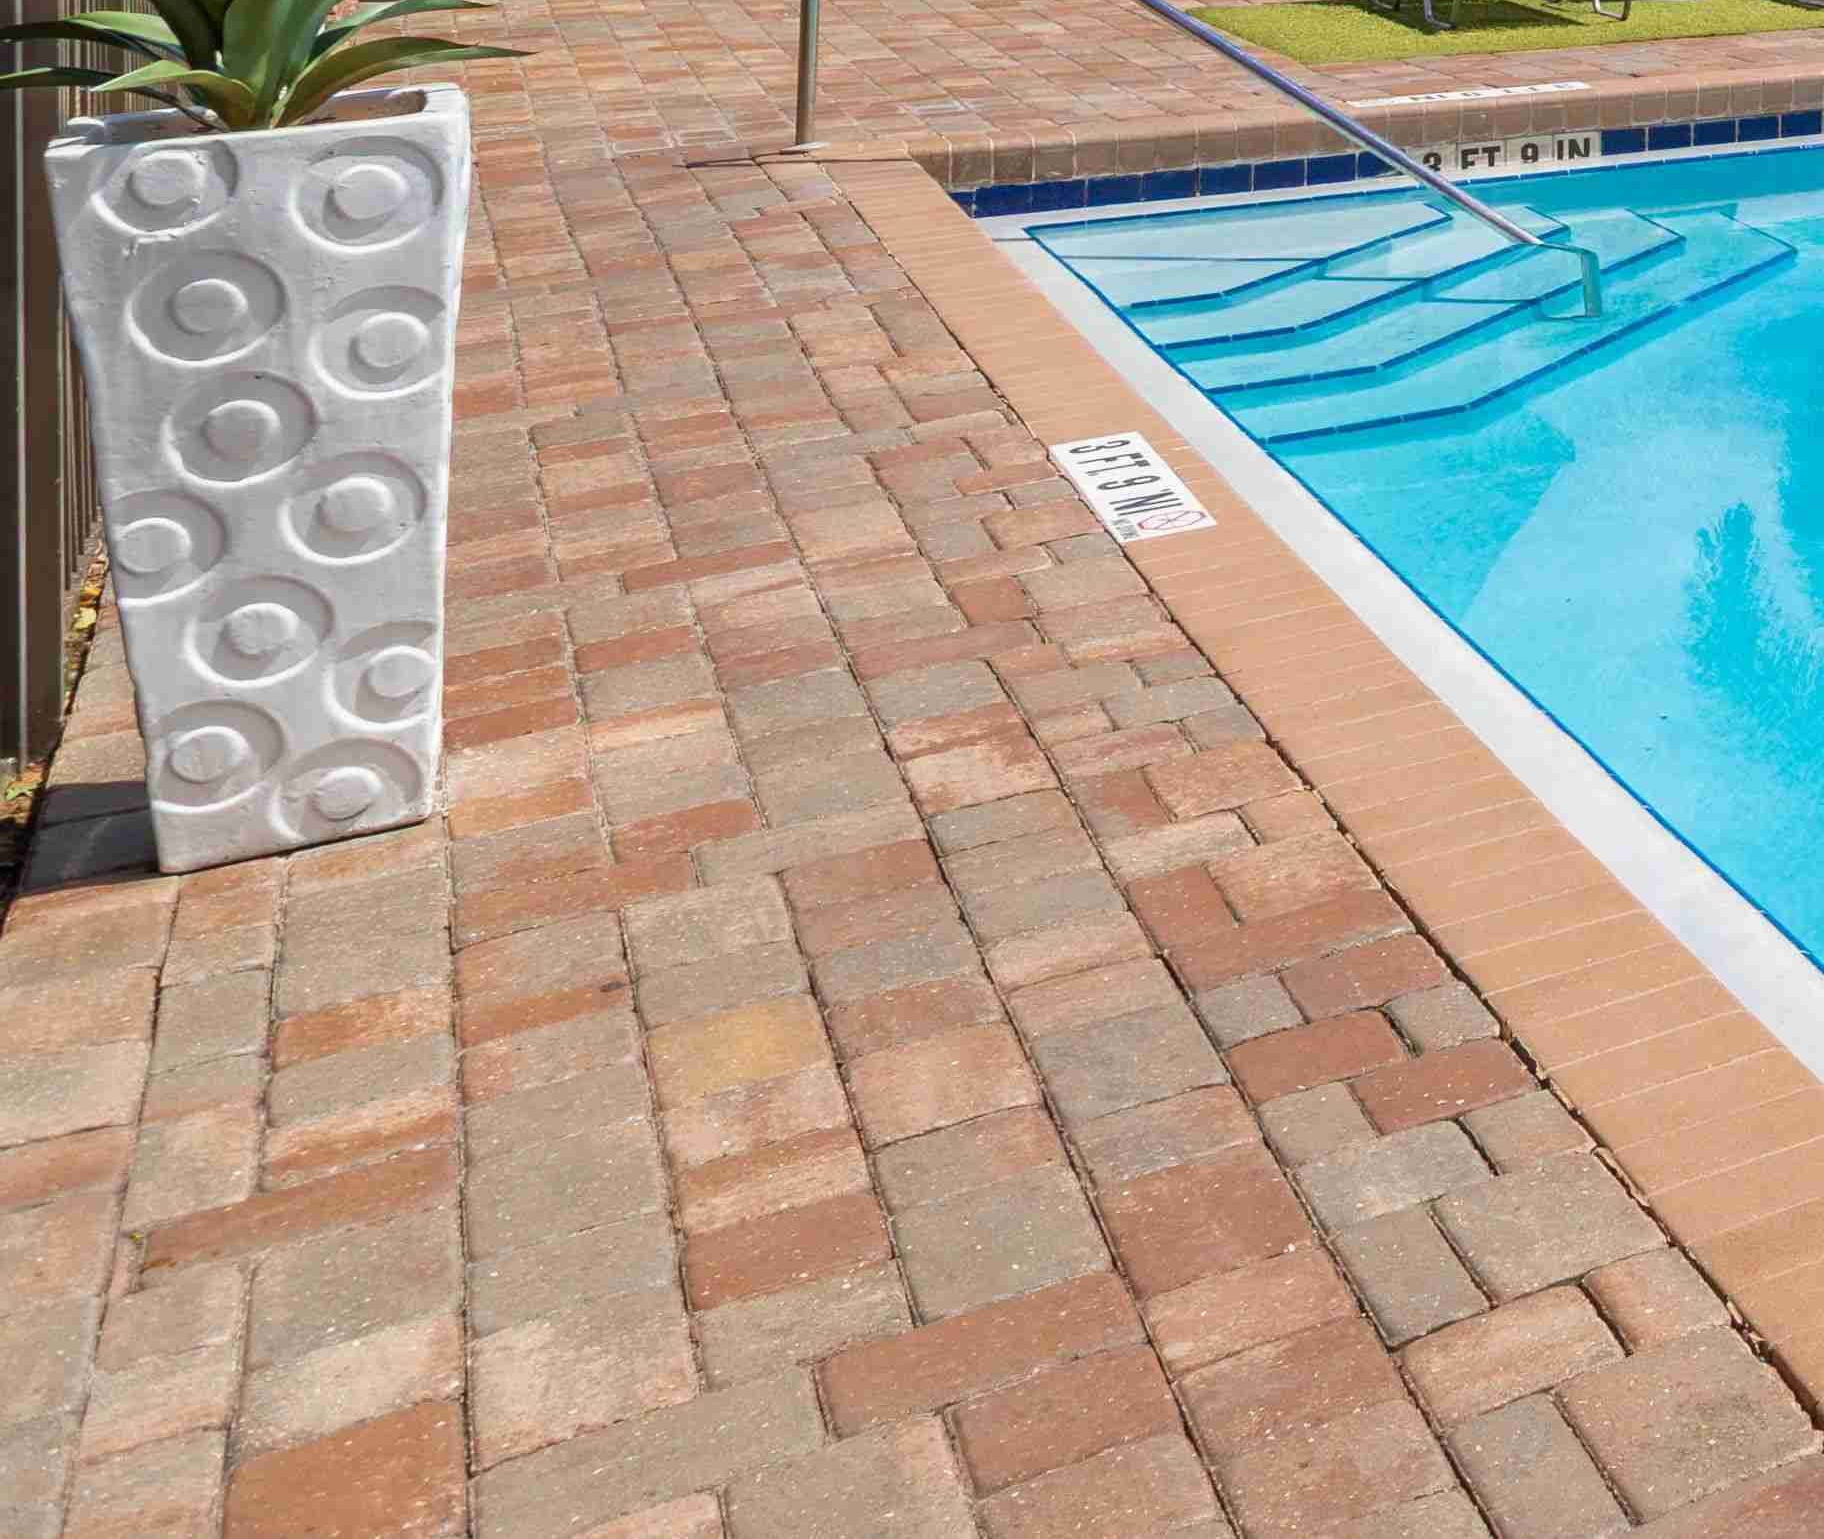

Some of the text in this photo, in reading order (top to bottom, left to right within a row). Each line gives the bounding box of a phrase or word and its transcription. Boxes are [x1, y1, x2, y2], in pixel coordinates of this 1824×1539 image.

[1461, 145, 1501, 170] FT
[1521, 142, 1539, 164] 9
[1556, 137, 1591, 160] IN
[1069, 439, 1131, 454] 3
[1096, 474, 1161, 491] 9
